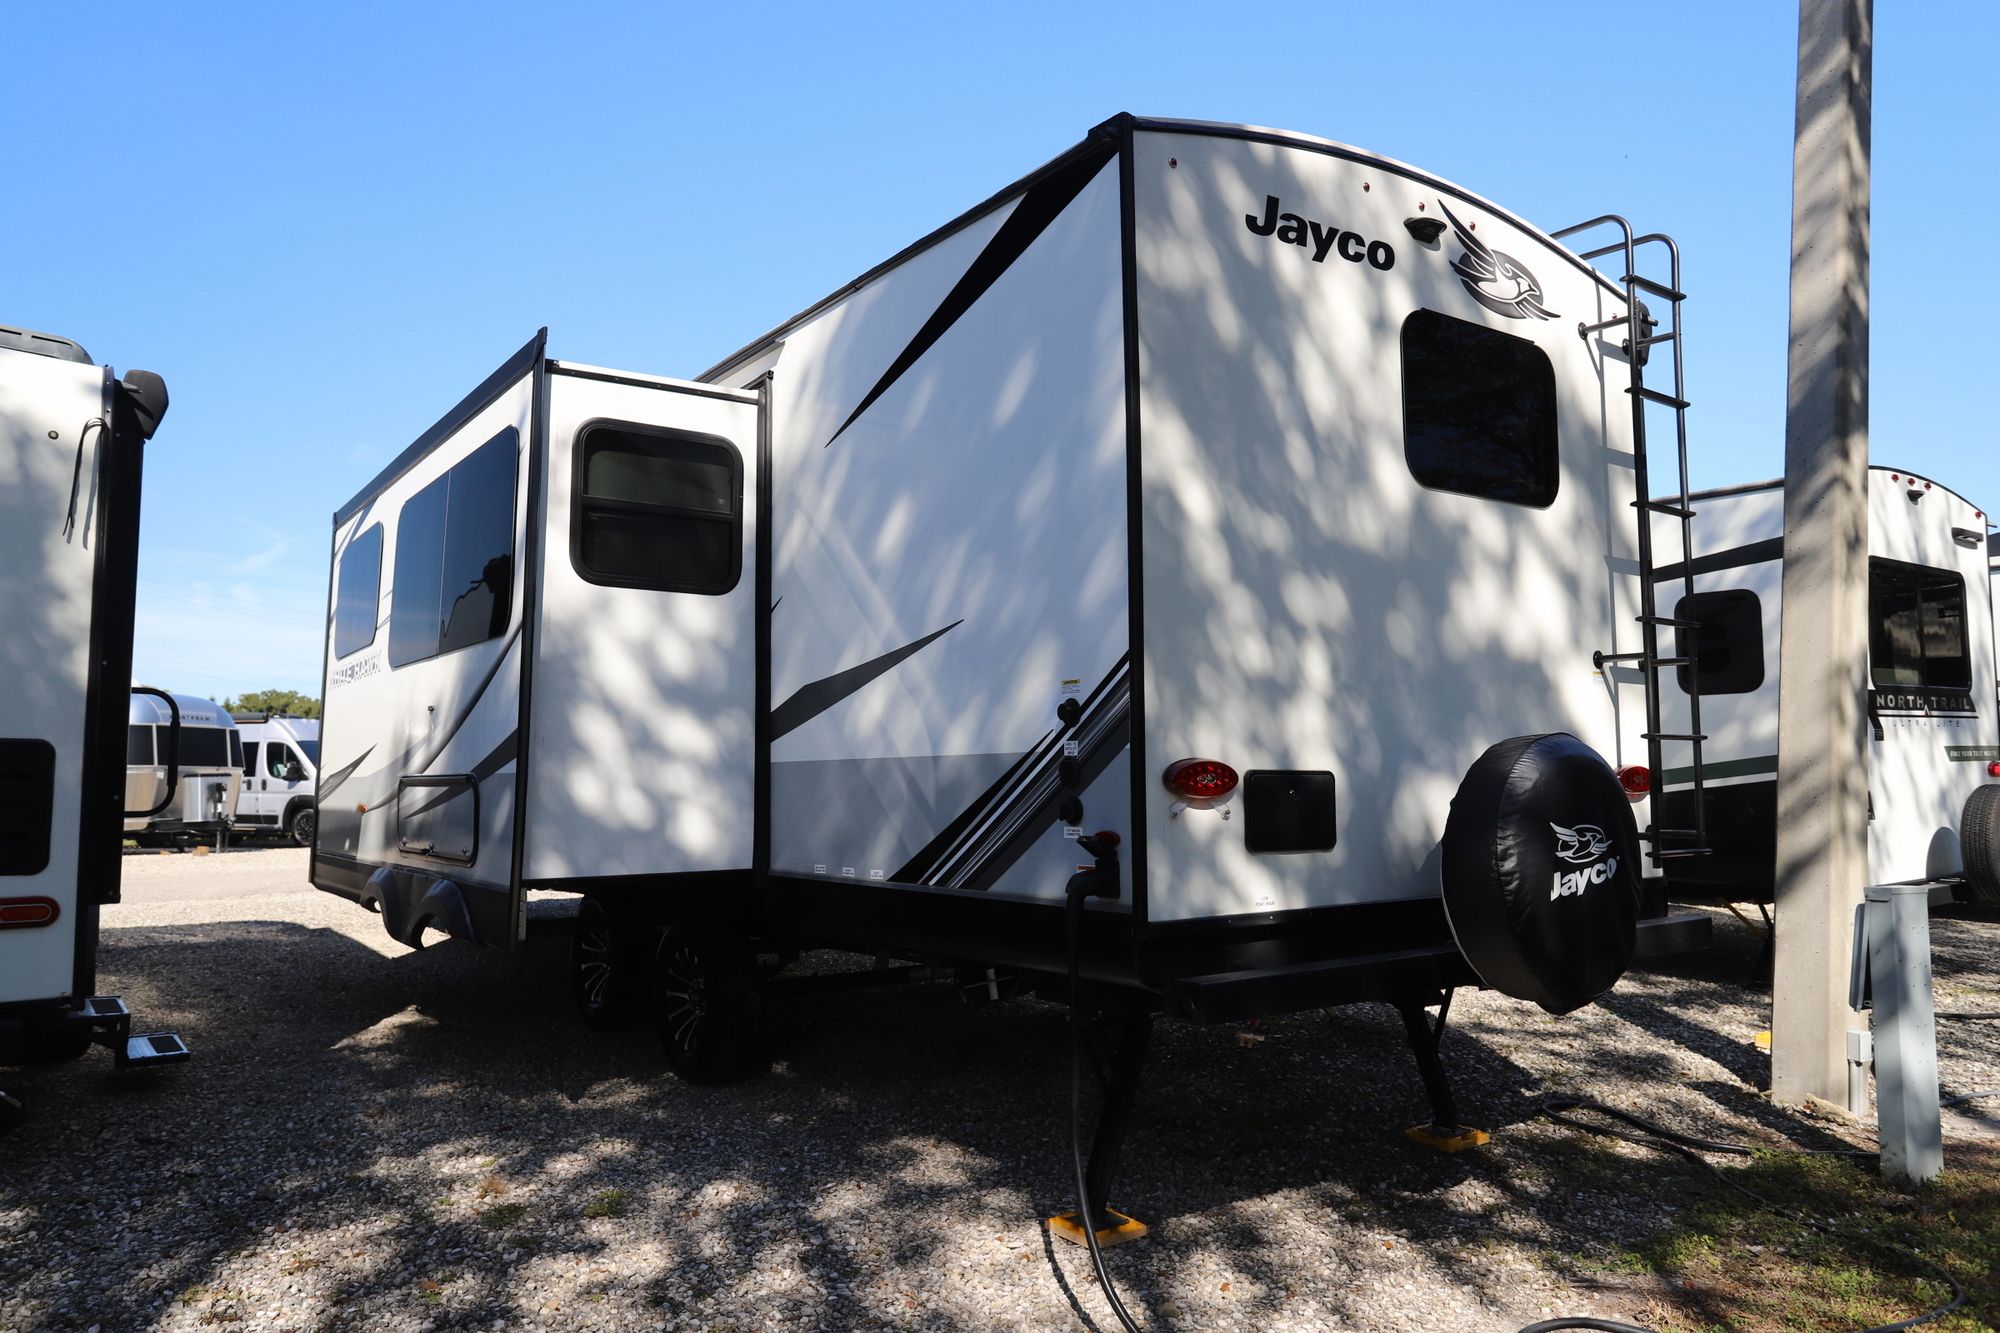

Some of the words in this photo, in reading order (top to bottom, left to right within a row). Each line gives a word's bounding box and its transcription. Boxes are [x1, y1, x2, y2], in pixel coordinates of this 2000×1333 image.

[1245, 195, 1395, 271] Jayco
[1876, 695, 1924, 709] NORTH
[1931, 696, 1970, 710] TRAIL
[1550, 857, 1617, 902] Jayco
